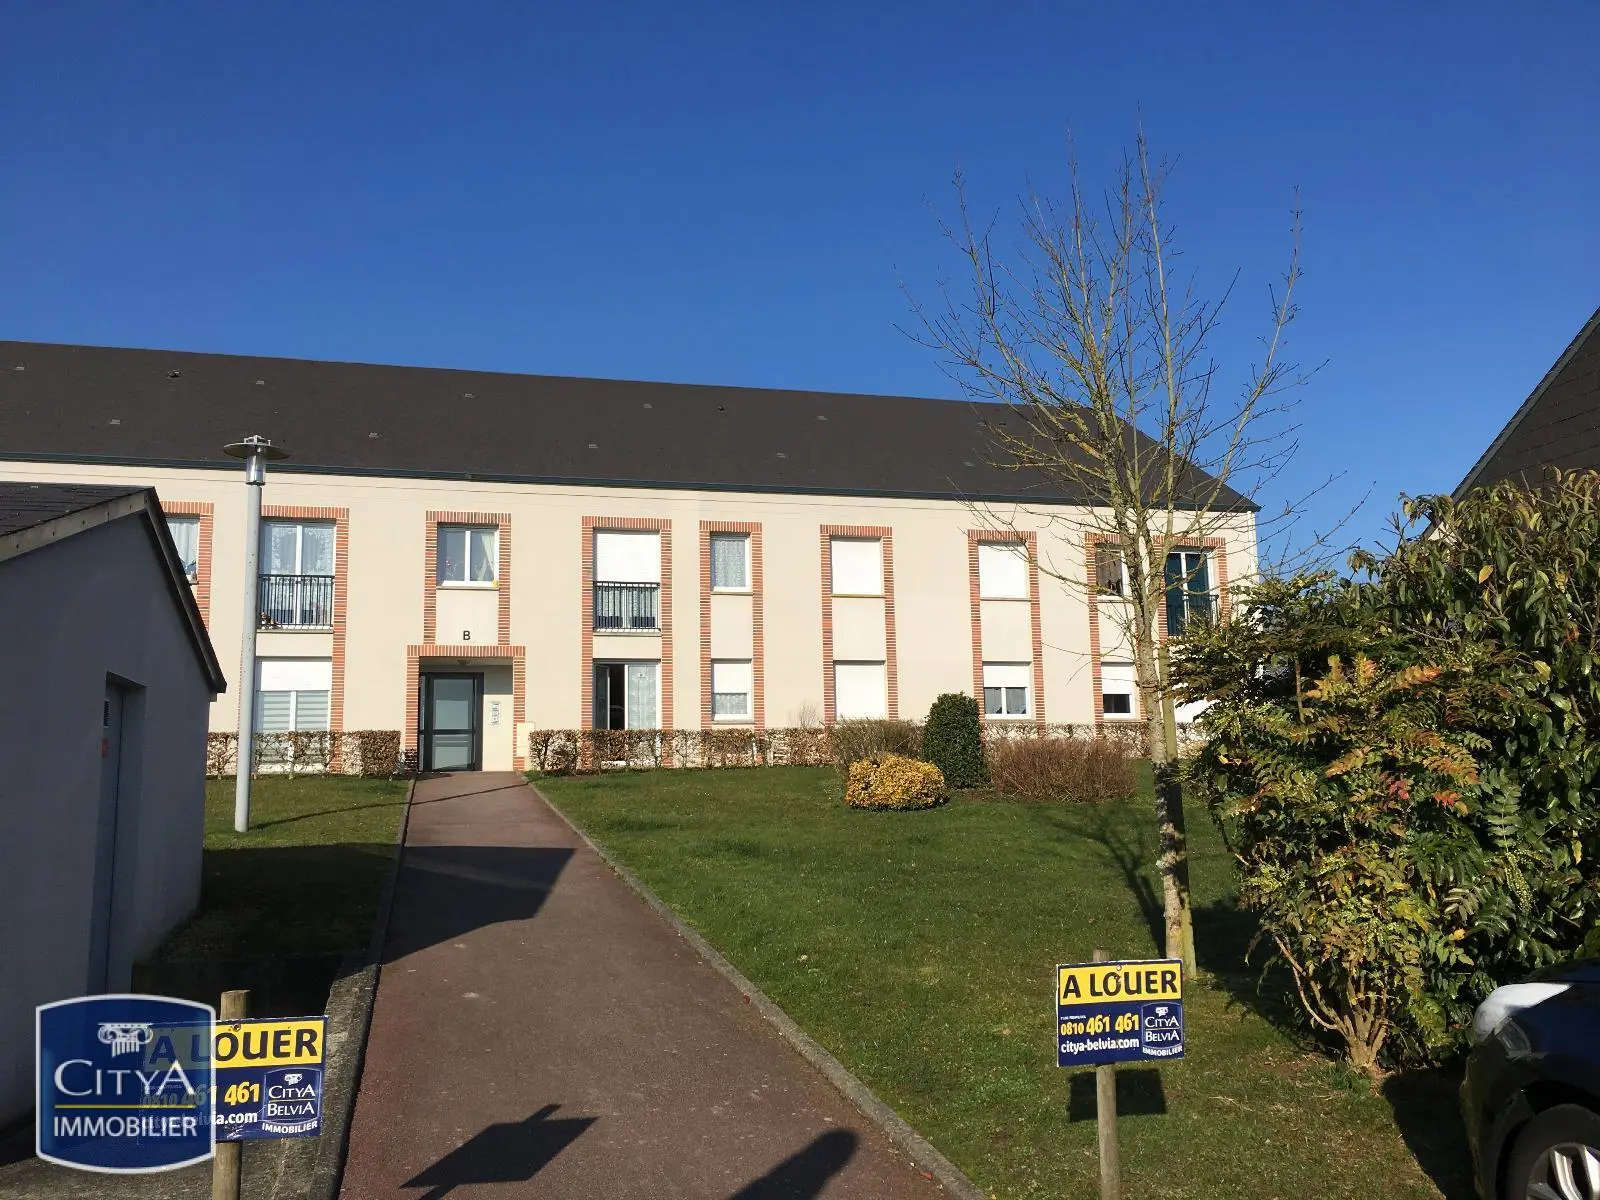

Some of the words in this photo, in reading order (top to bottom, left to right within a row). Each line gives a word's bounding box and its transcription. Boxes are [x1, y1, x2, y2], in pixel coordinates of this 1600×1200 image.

[463, 630, 471, 641] B
[1063, 974, 1082, 999] A
[1090, 970, 1178, 997] LOUER
[1060, 1021, 1085, 1036] 0810
[1086, 1014, 1111, 1035] 461
[1115, 1012, 1140, 1033] 461
[191, 1029, 318, 1062] LOUER
[1061, 1037, 1140, 1055] citya-belvia.com
[1142, 1045, 1183, 1057] IMMOBILIER
[224, 1081, 260, 1106] 461
[262, 1120, 319, 1134] IMMOBILIER
